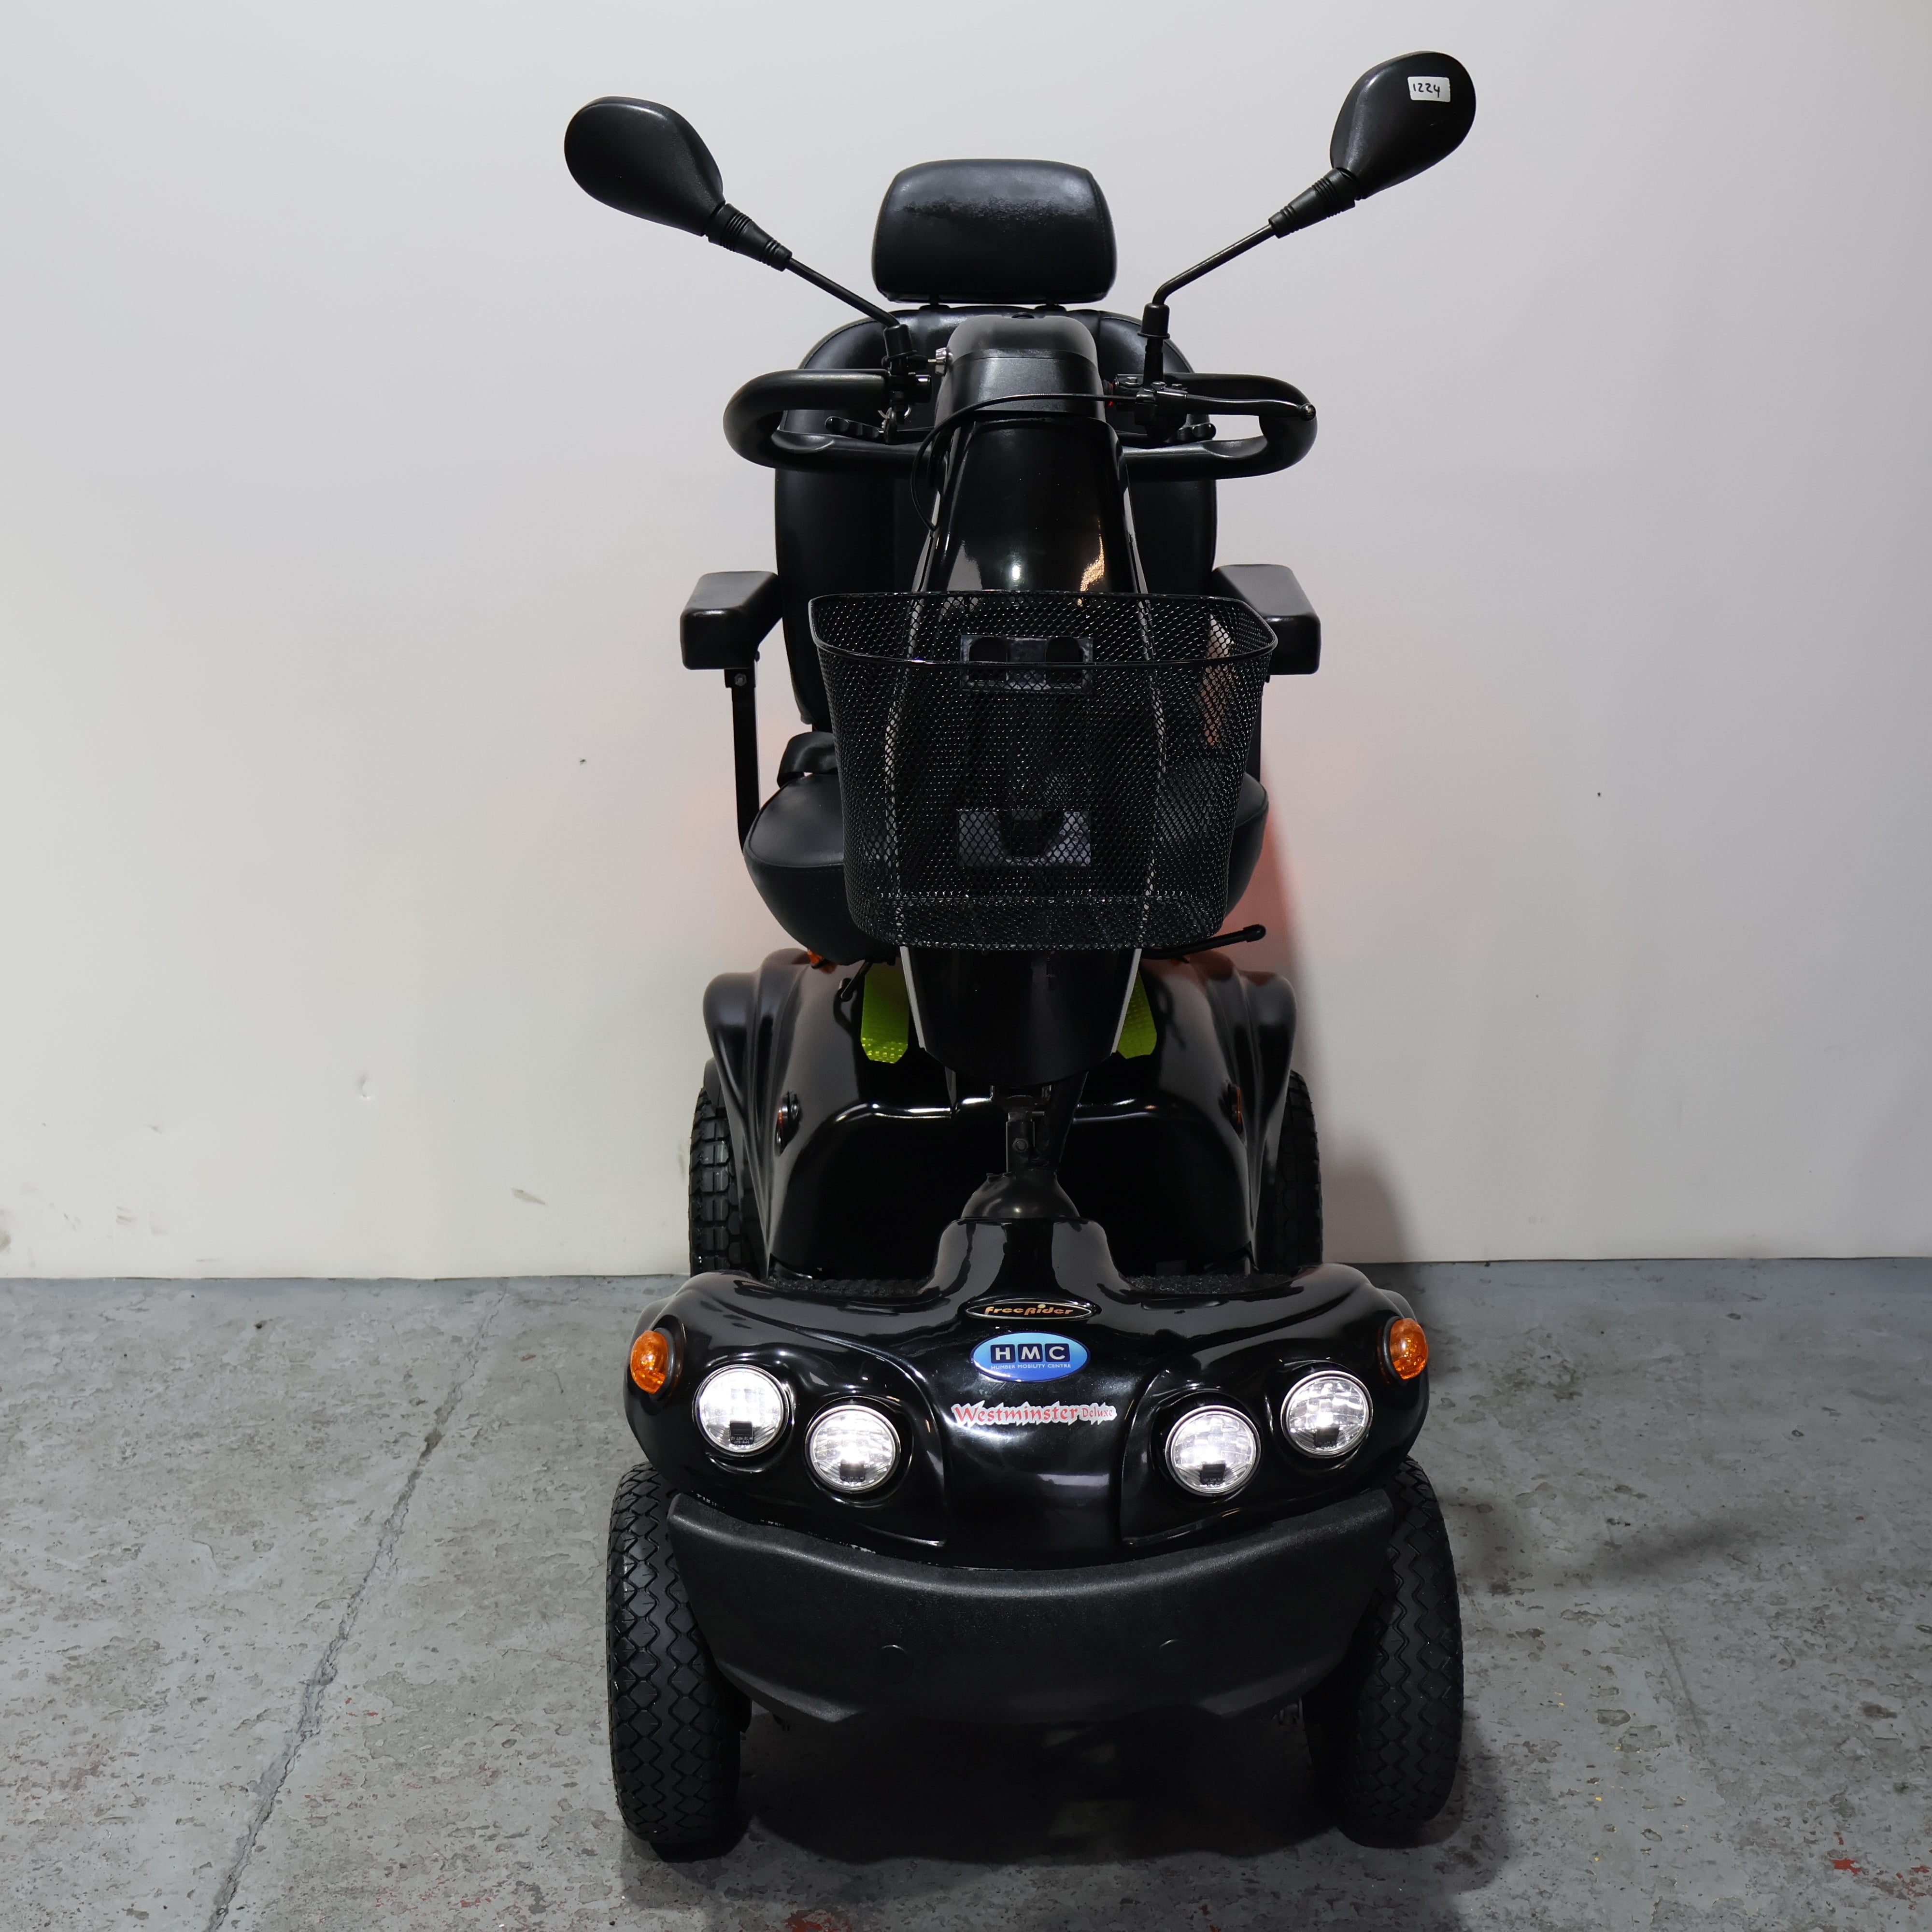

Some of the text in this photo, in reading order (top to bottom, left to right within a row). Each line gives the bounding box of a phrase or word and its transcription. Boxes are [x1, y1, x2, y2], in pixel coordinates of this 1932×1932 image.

[1413, 83, 1440, 98] 1224
[995, 1346, 1065, 1361] HMC
[954, 1406, 1113, 1421] Westminster Deluxe
